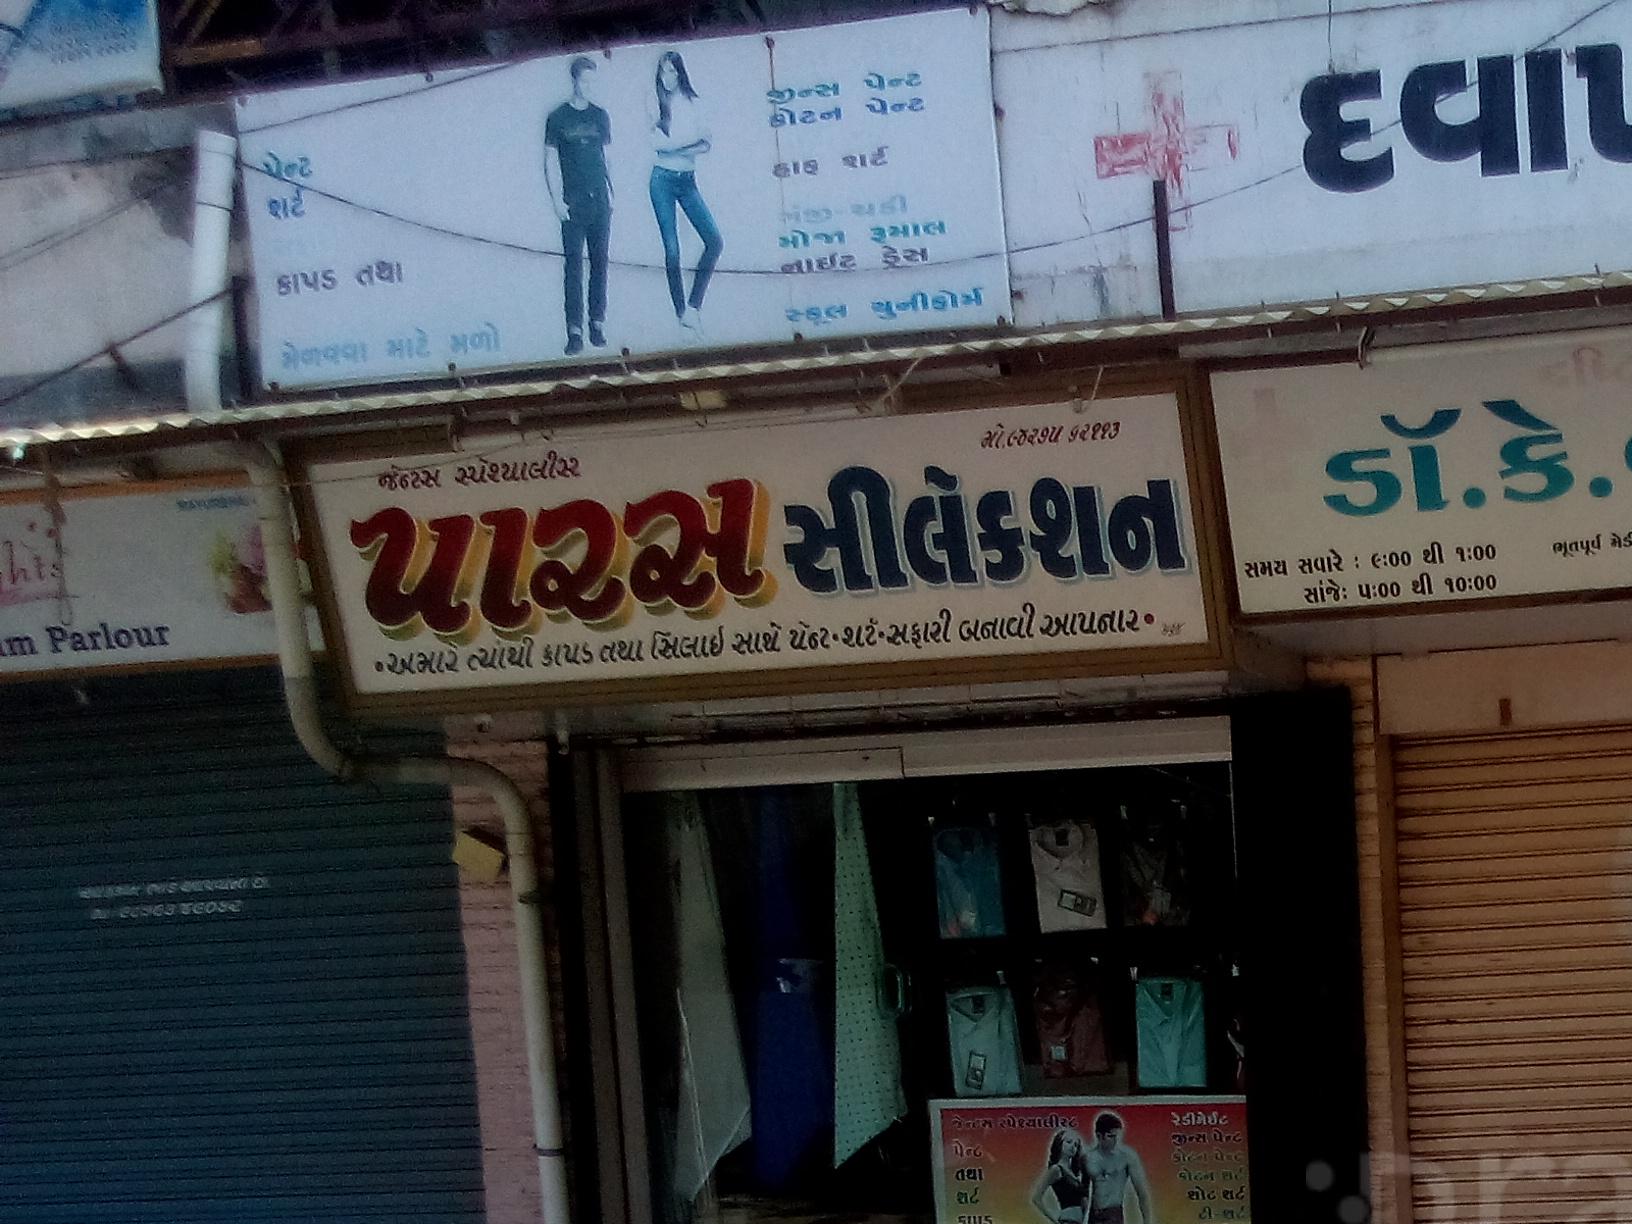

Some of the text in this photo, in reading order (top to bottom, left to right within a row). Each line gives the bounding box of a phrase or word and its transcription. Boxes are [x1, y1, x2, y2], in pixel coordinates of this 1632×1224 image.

[349, 477, 772, 640] પારસ
[1244, 559, 1288, 578] સમય
[1298, 549, 1344, 575] સવારે
[1423, 541, 1444, 565] થી
[1412, 572, 1434, 596] થી
[45, 622, 170, 654] Parlour
[541, 642, 594, 669] કાપડ
[600, 637, 644, 665] તથા
[731, 621, 782, 657] સાથે
[958, 601, 1036, 643] બનાવી
[955, 1168, 984, 1181] તથા
